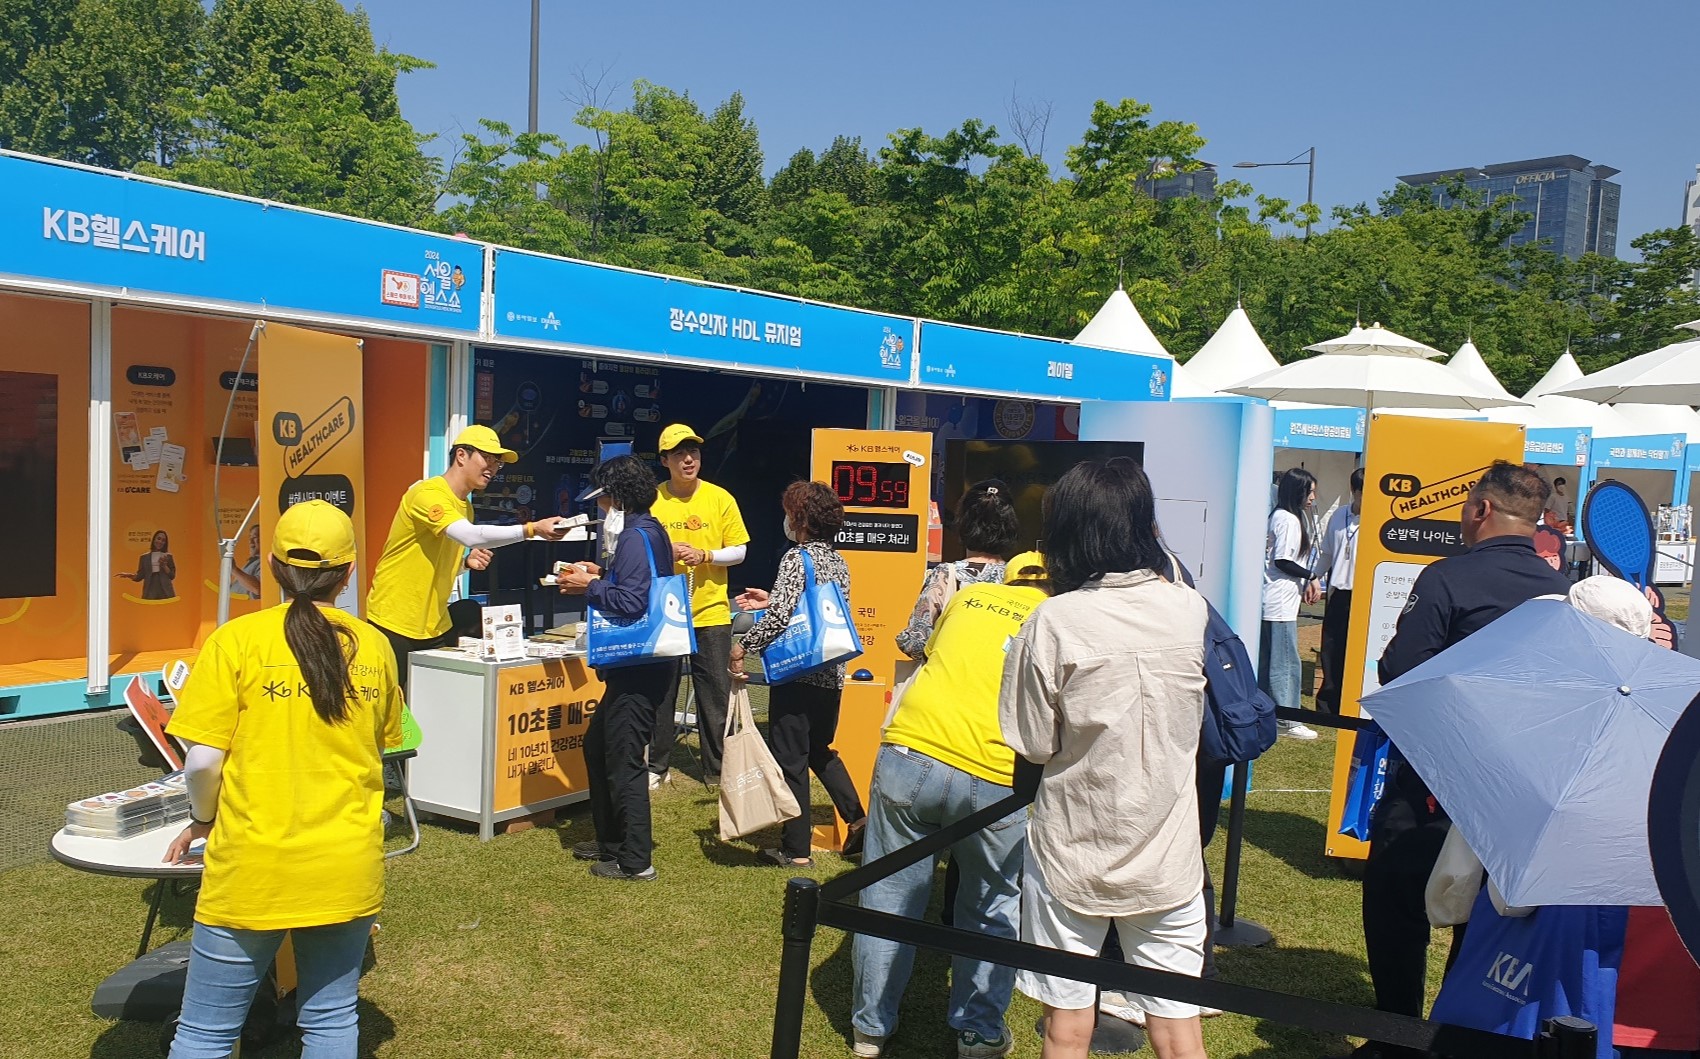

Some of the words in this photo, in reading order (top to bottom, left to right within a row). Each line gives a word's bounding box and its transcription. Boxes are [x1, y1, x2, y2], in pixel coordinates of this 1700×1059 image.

[1516, 171, 1555, 184] OFFICIA
[42, 206, 206, 262] KB헬스케어
[424, 250, 440, 260] 2024
[424, 261, 452, 290] 서울
[669, 307, 728, 337] 장수인자
[732, 318, 761, 343] HDL
[764, 321, 803, 348] 뮤지엄
[1047, 360, 1074, 380] 레이델
[279, 418, 297, 438] KB
[288, 412, 345, 469] HEALTHCARE
[860, 445, 874, 453] KB
[1388, 478, 1413, 493] KB
[325, 490, 347, 506] 이벤트
[1399, 478, 1481, 514] HEALTHCAR
[867, 532, 886, 545] 매우
[1386, 527, 1420, 542] 순발력
[1423, 530, 1456, 545] 나이는
[1383, 575, 1406, 586] 간단한
[857, 607, 876, 618] 국민
[986, 603, 1011, 617] KB
[509, 683, 525, 696] KB
[527, 676, 565, 694] 헬스케어
[508, 704, 562, 736] 10초를
[568, 698, 599, 725] 매우
[508, 747, 518, 762] 네
[520, 741, 549, 759] 10년치
[508, 763, 527, 779] 내가
[528, 756, 556, 776] 알렸다
